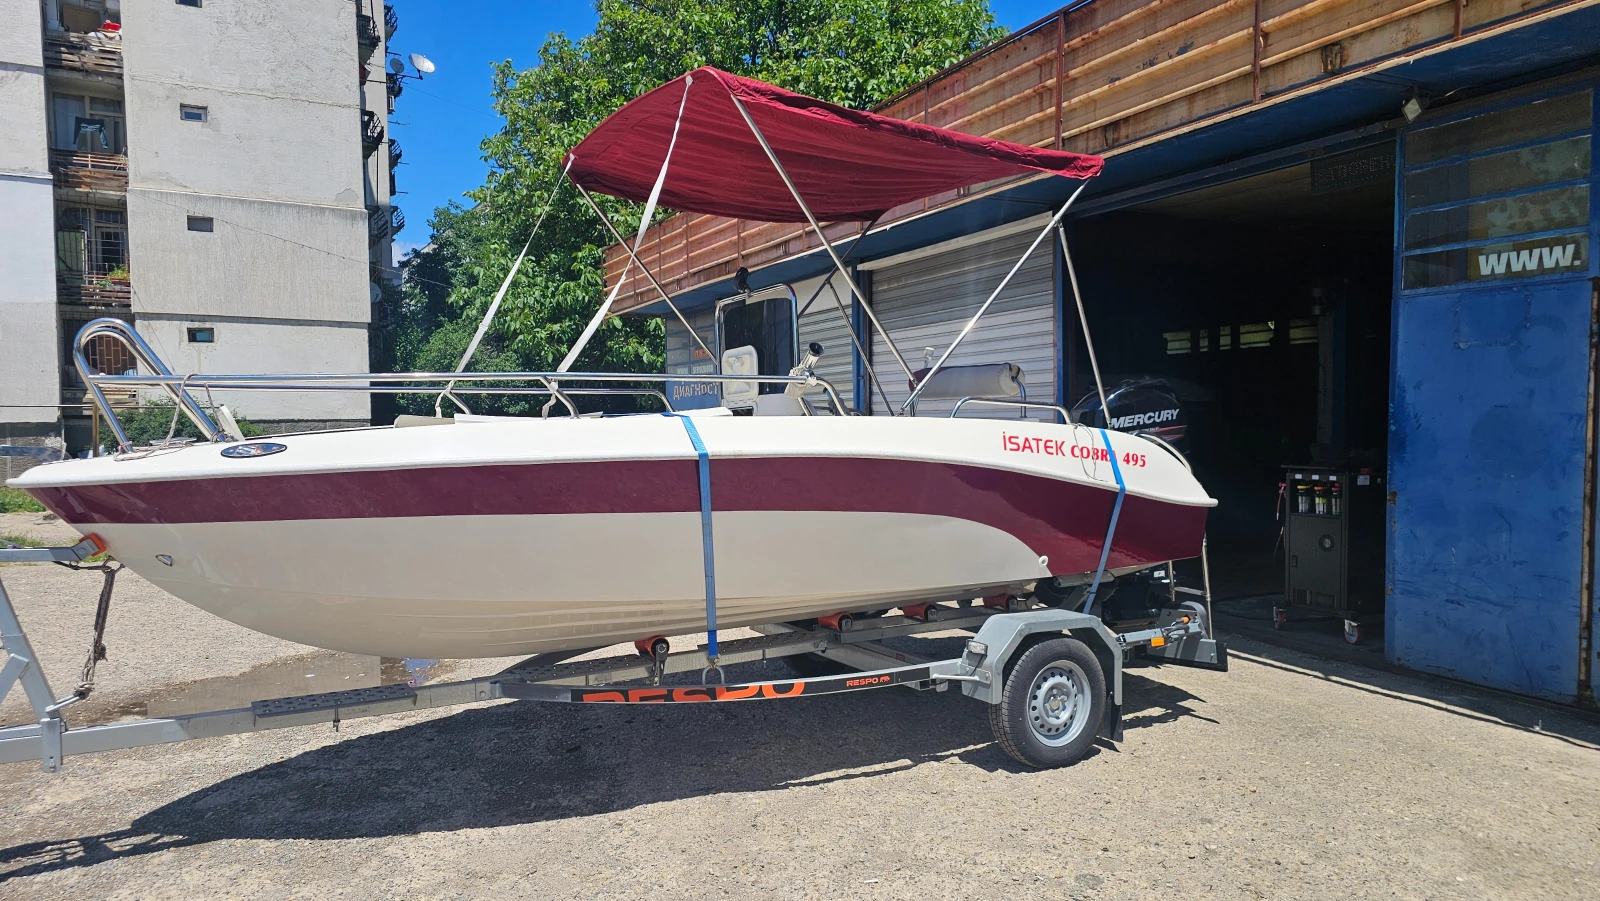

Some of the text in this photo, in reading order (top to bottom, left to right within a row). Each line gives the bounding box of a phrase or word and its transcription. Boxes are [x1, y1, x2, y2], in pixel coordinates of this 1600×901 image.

[1478, 243, 1581, 276] www.
[1110, 408, 1180, 429] MERCURY
[1122, 451, 1147, 468] 495
[846, 677, 879, 687] RESPO
